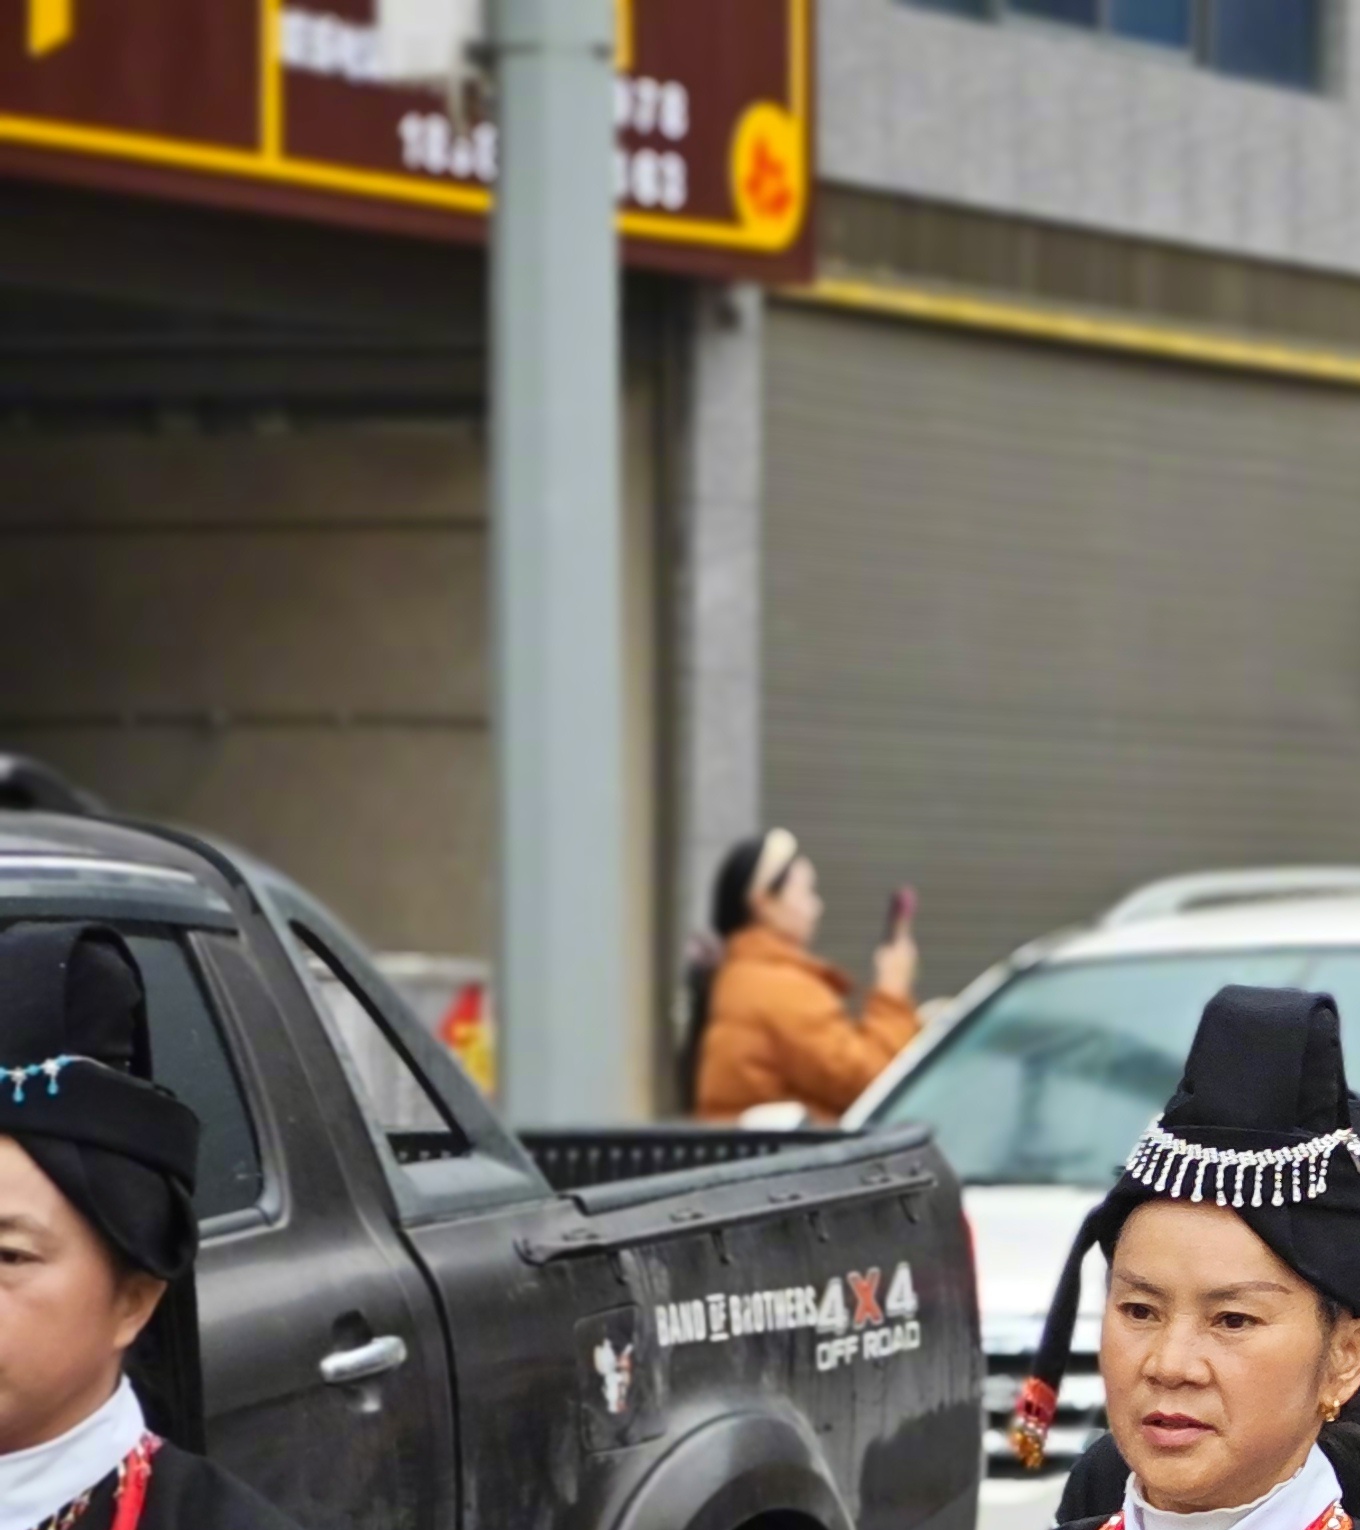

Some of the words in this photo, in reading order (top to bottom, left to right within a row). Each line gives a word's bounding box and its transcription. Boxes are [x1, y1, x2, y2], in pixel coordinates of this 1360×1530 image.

[655, 1299, 707, 1347] BAND
[705, 1293, 730, 1342] OF
[729, 1285, 818, 1337] BROTHERS
[816, 1334, 860, 1372] OFF
[862, 1320, 921, 1361] ROAD
